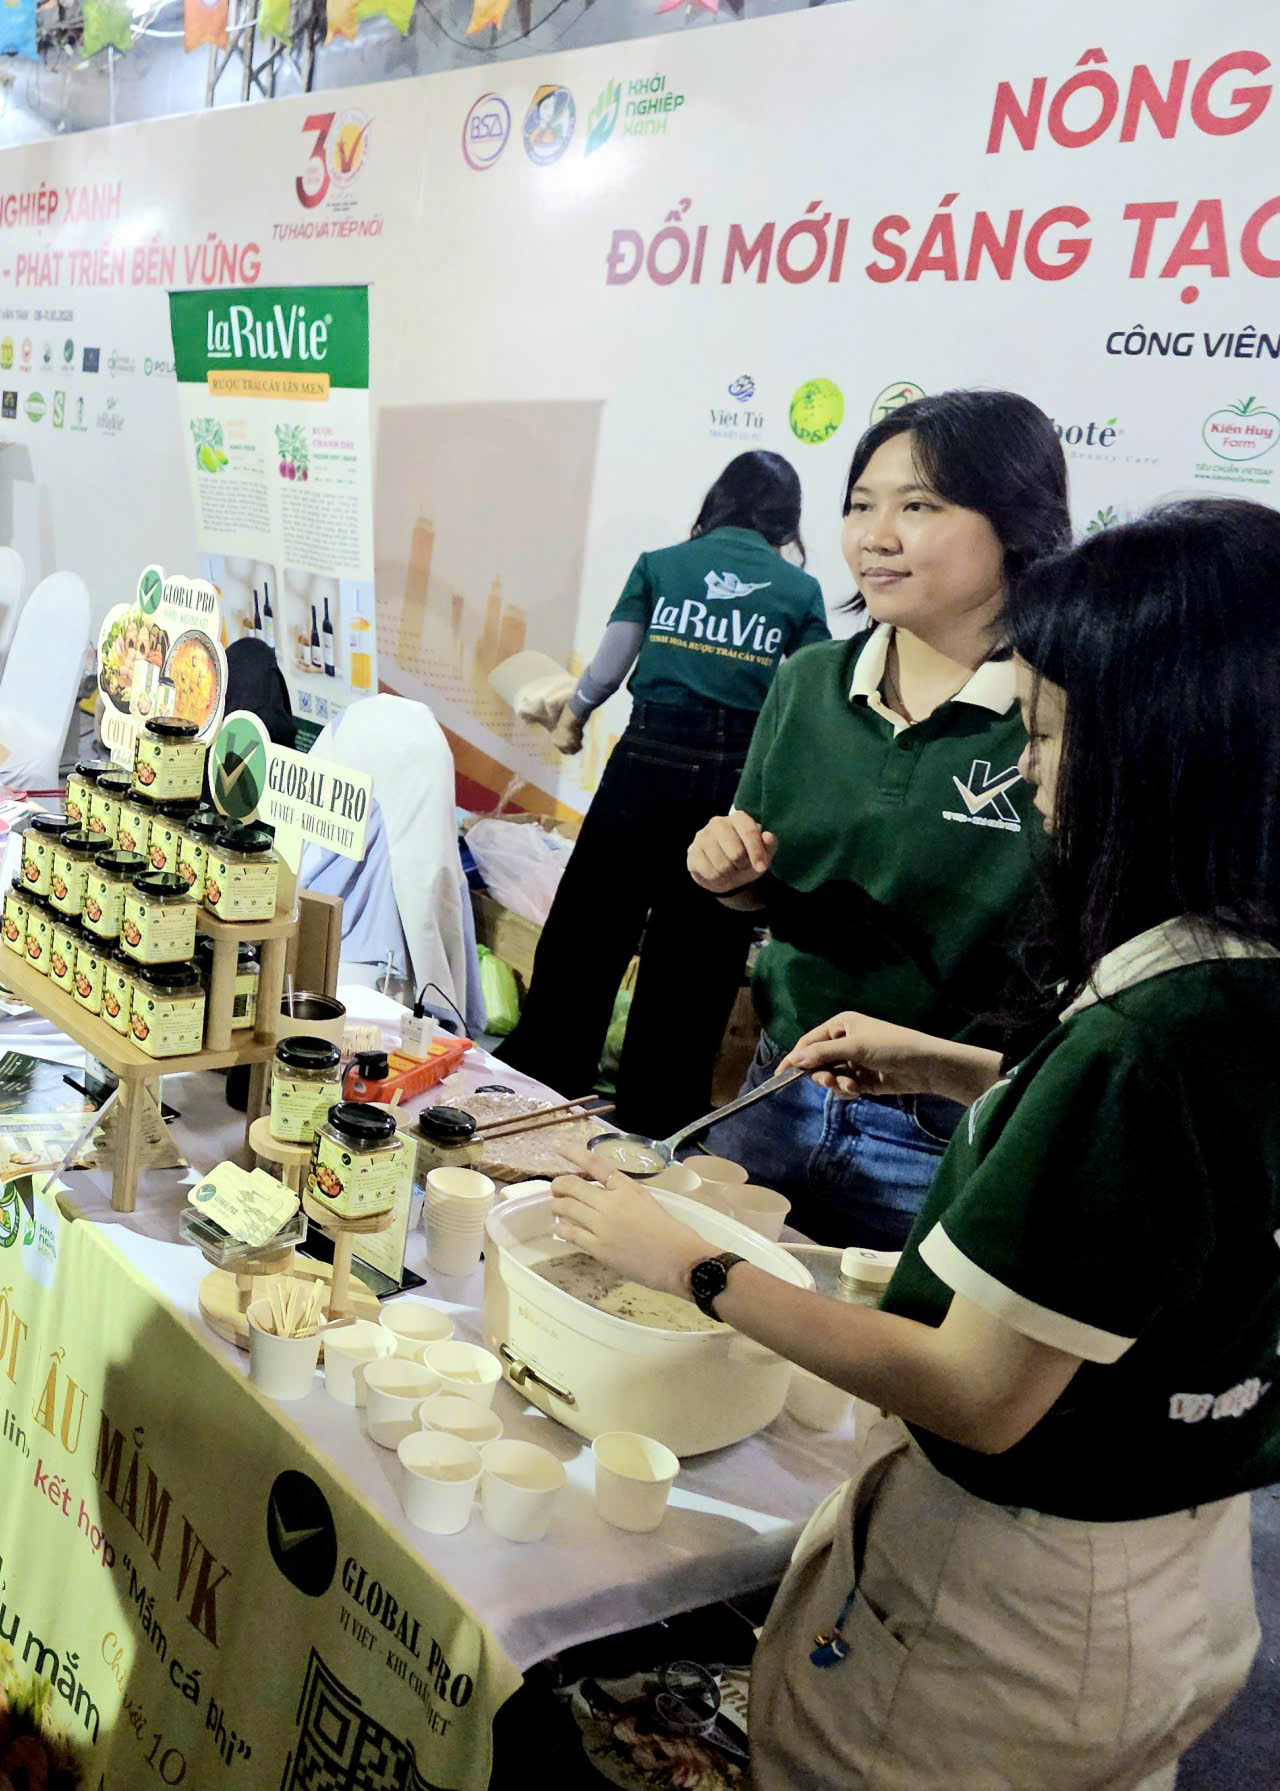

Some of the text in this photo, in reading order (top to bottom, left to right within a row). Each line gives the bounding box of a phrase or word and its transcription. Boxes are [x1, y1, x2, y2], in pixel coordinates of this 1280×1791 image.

[986, 48, 1272, 154] NÔNG
[184, 232, 262, 286] VỮNG
[605, 198, 708, 285] ĐỔI
[721, 200, 849, 284] MỚI
[865, 192, 1093, 283] SÁNG
[207, 304, 328, 360] laRuVie
[1106, 323, 1280, 359] CÔNG VIÊN
[1222, 437, 1256, 449] Farm
[163, 583, 215, 614] GLOBAL PRO
[649, 596, 783, 655] laRuVie
[268, 757, 367, 822] GLOBAL PRO
[92, 1409, 174, 1570] MẮM
[176, 1514, 232, 1649] VK
[32, 1458, 73, 1518] kết
[169, 1657, 202, 1705] cá
[341, 1556, 474, 1708] GLOBAL PRO
